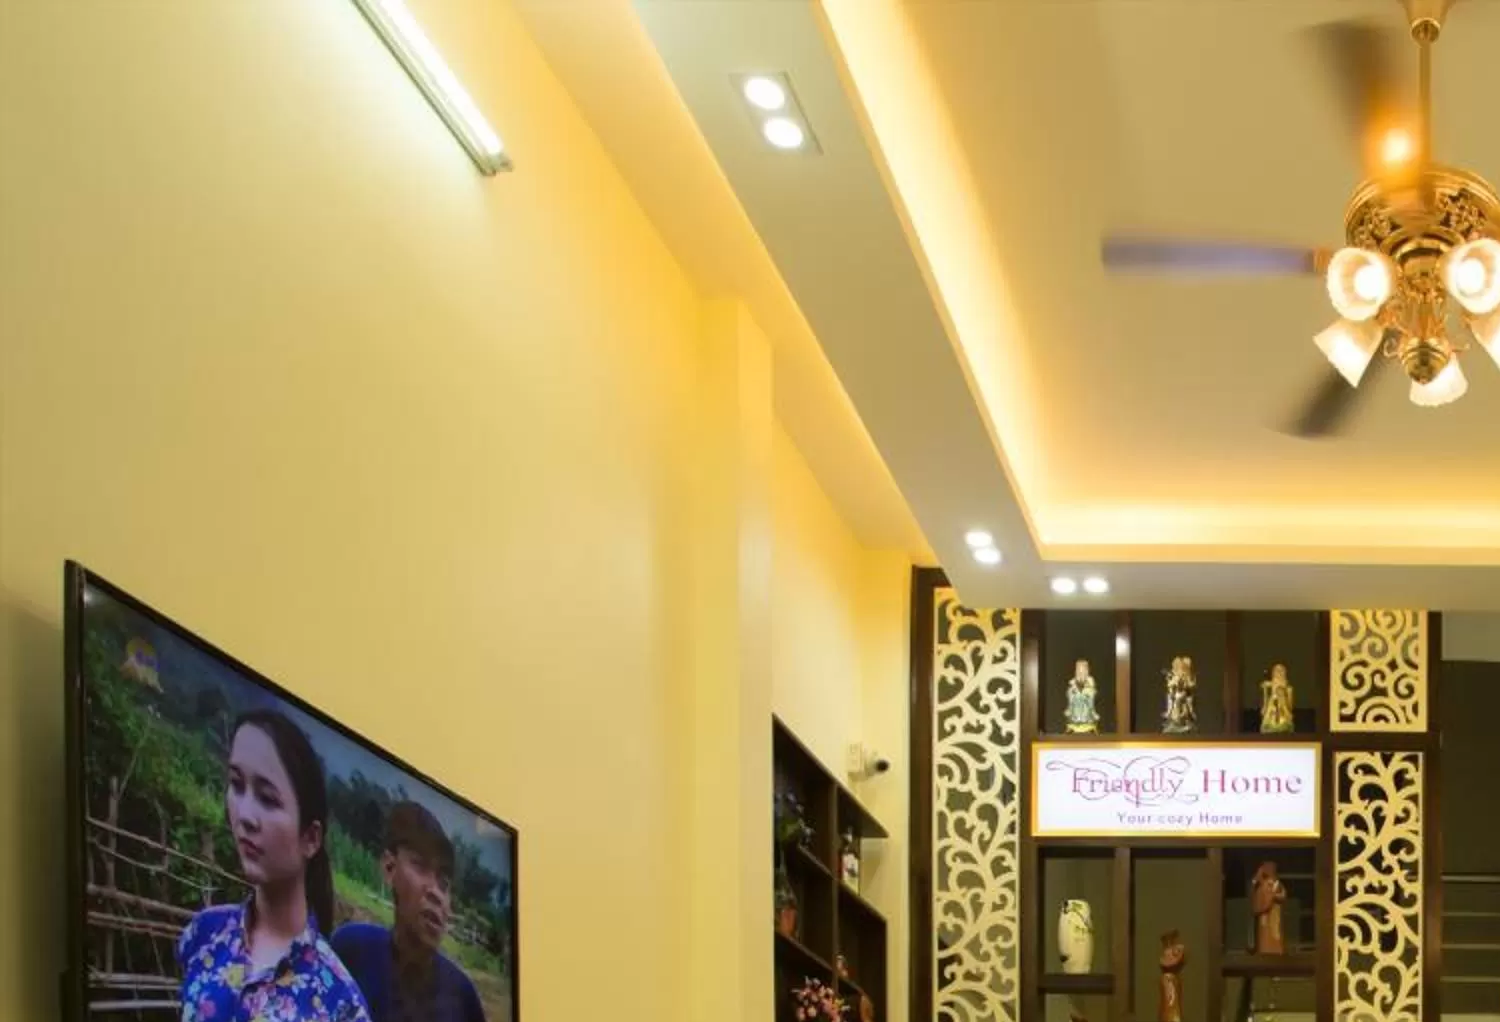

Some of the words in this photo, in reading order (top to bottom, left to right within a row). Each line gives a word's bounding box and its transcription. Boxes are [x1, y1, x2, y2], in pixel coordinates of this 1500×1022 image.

[1046, 756, 1199, 808] Friendly
[1204, 769, 1302, 794] Home
[1116, 811, 1152, 825] Your
[1158, 814, 1193, 826] cozy
[1199, 811, 1243, 825] Home
